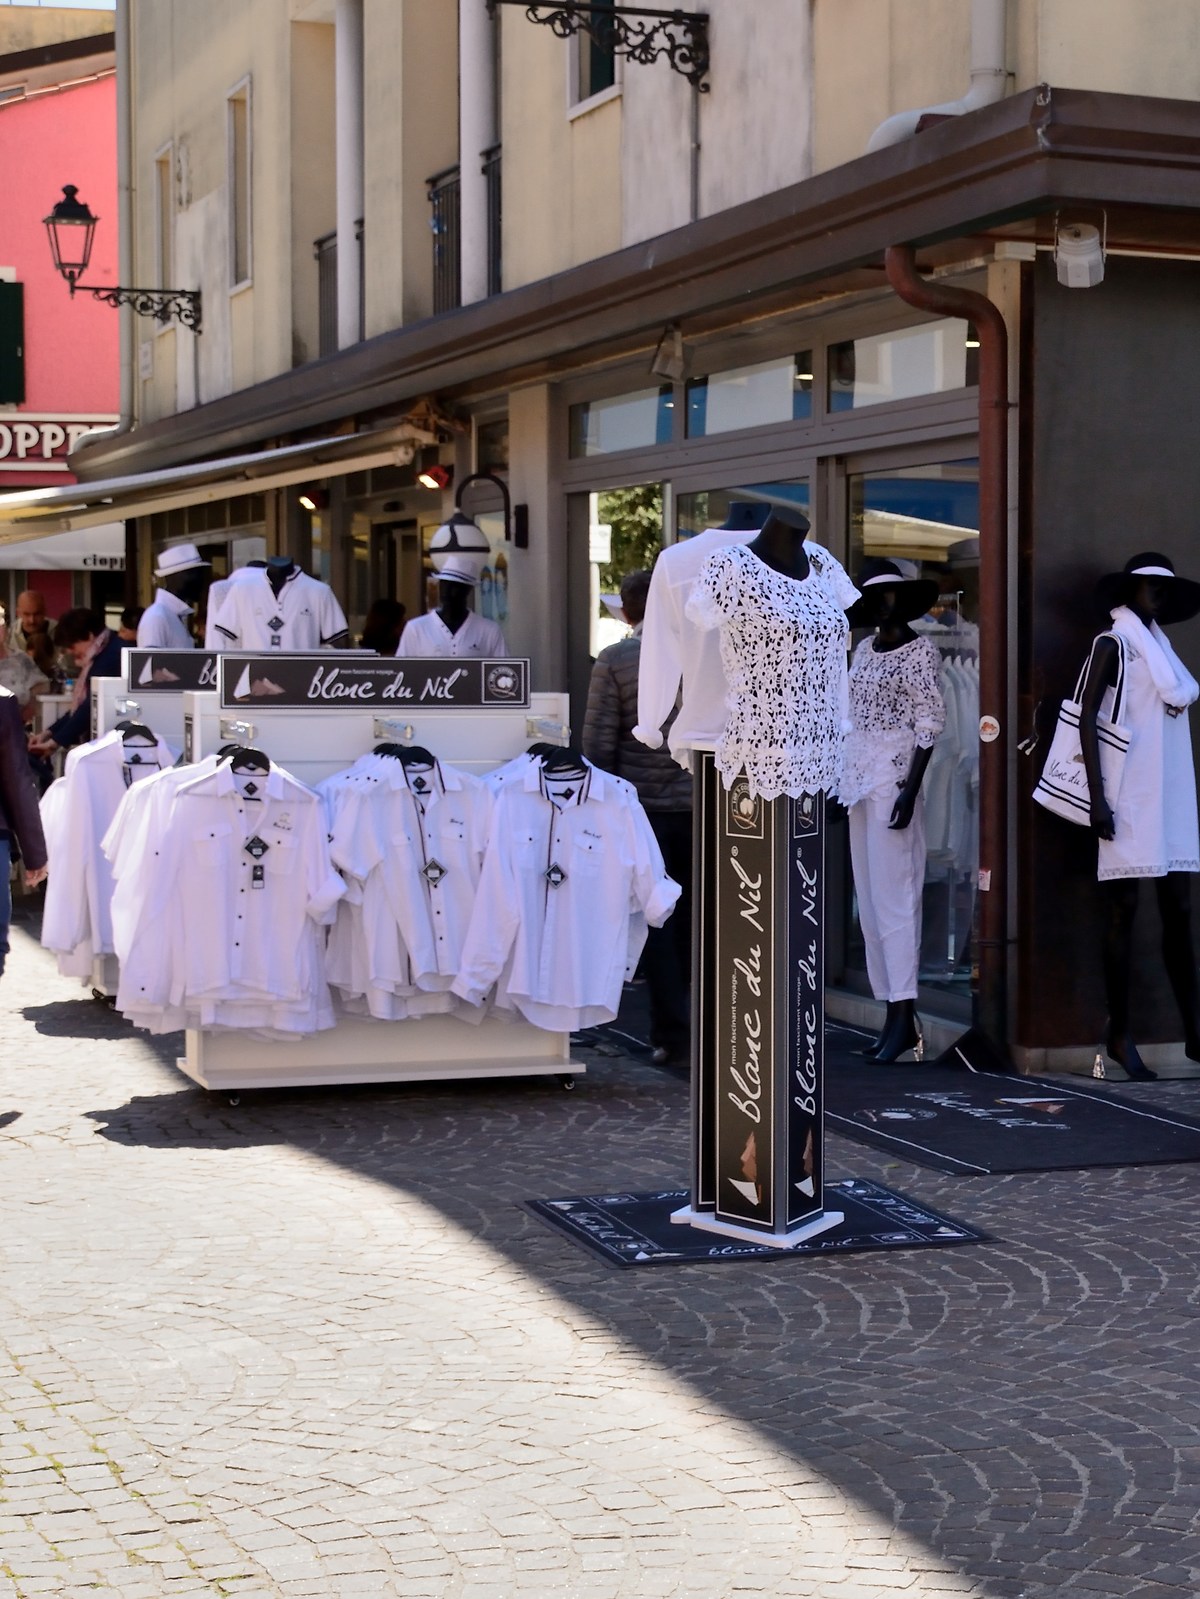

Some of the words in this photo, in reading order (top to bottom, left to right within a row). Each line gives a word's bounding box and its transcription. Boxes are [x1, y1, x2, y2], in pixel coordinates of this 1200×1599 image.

[382, 671, 414, 699] du
[420, 668, 462, 701] Nil
[730, 857, 764, 932] Nil
[796, 859, 818, 926] Nil
[733, 944, 762, 997] du
[798, 940, 817, 991] du
